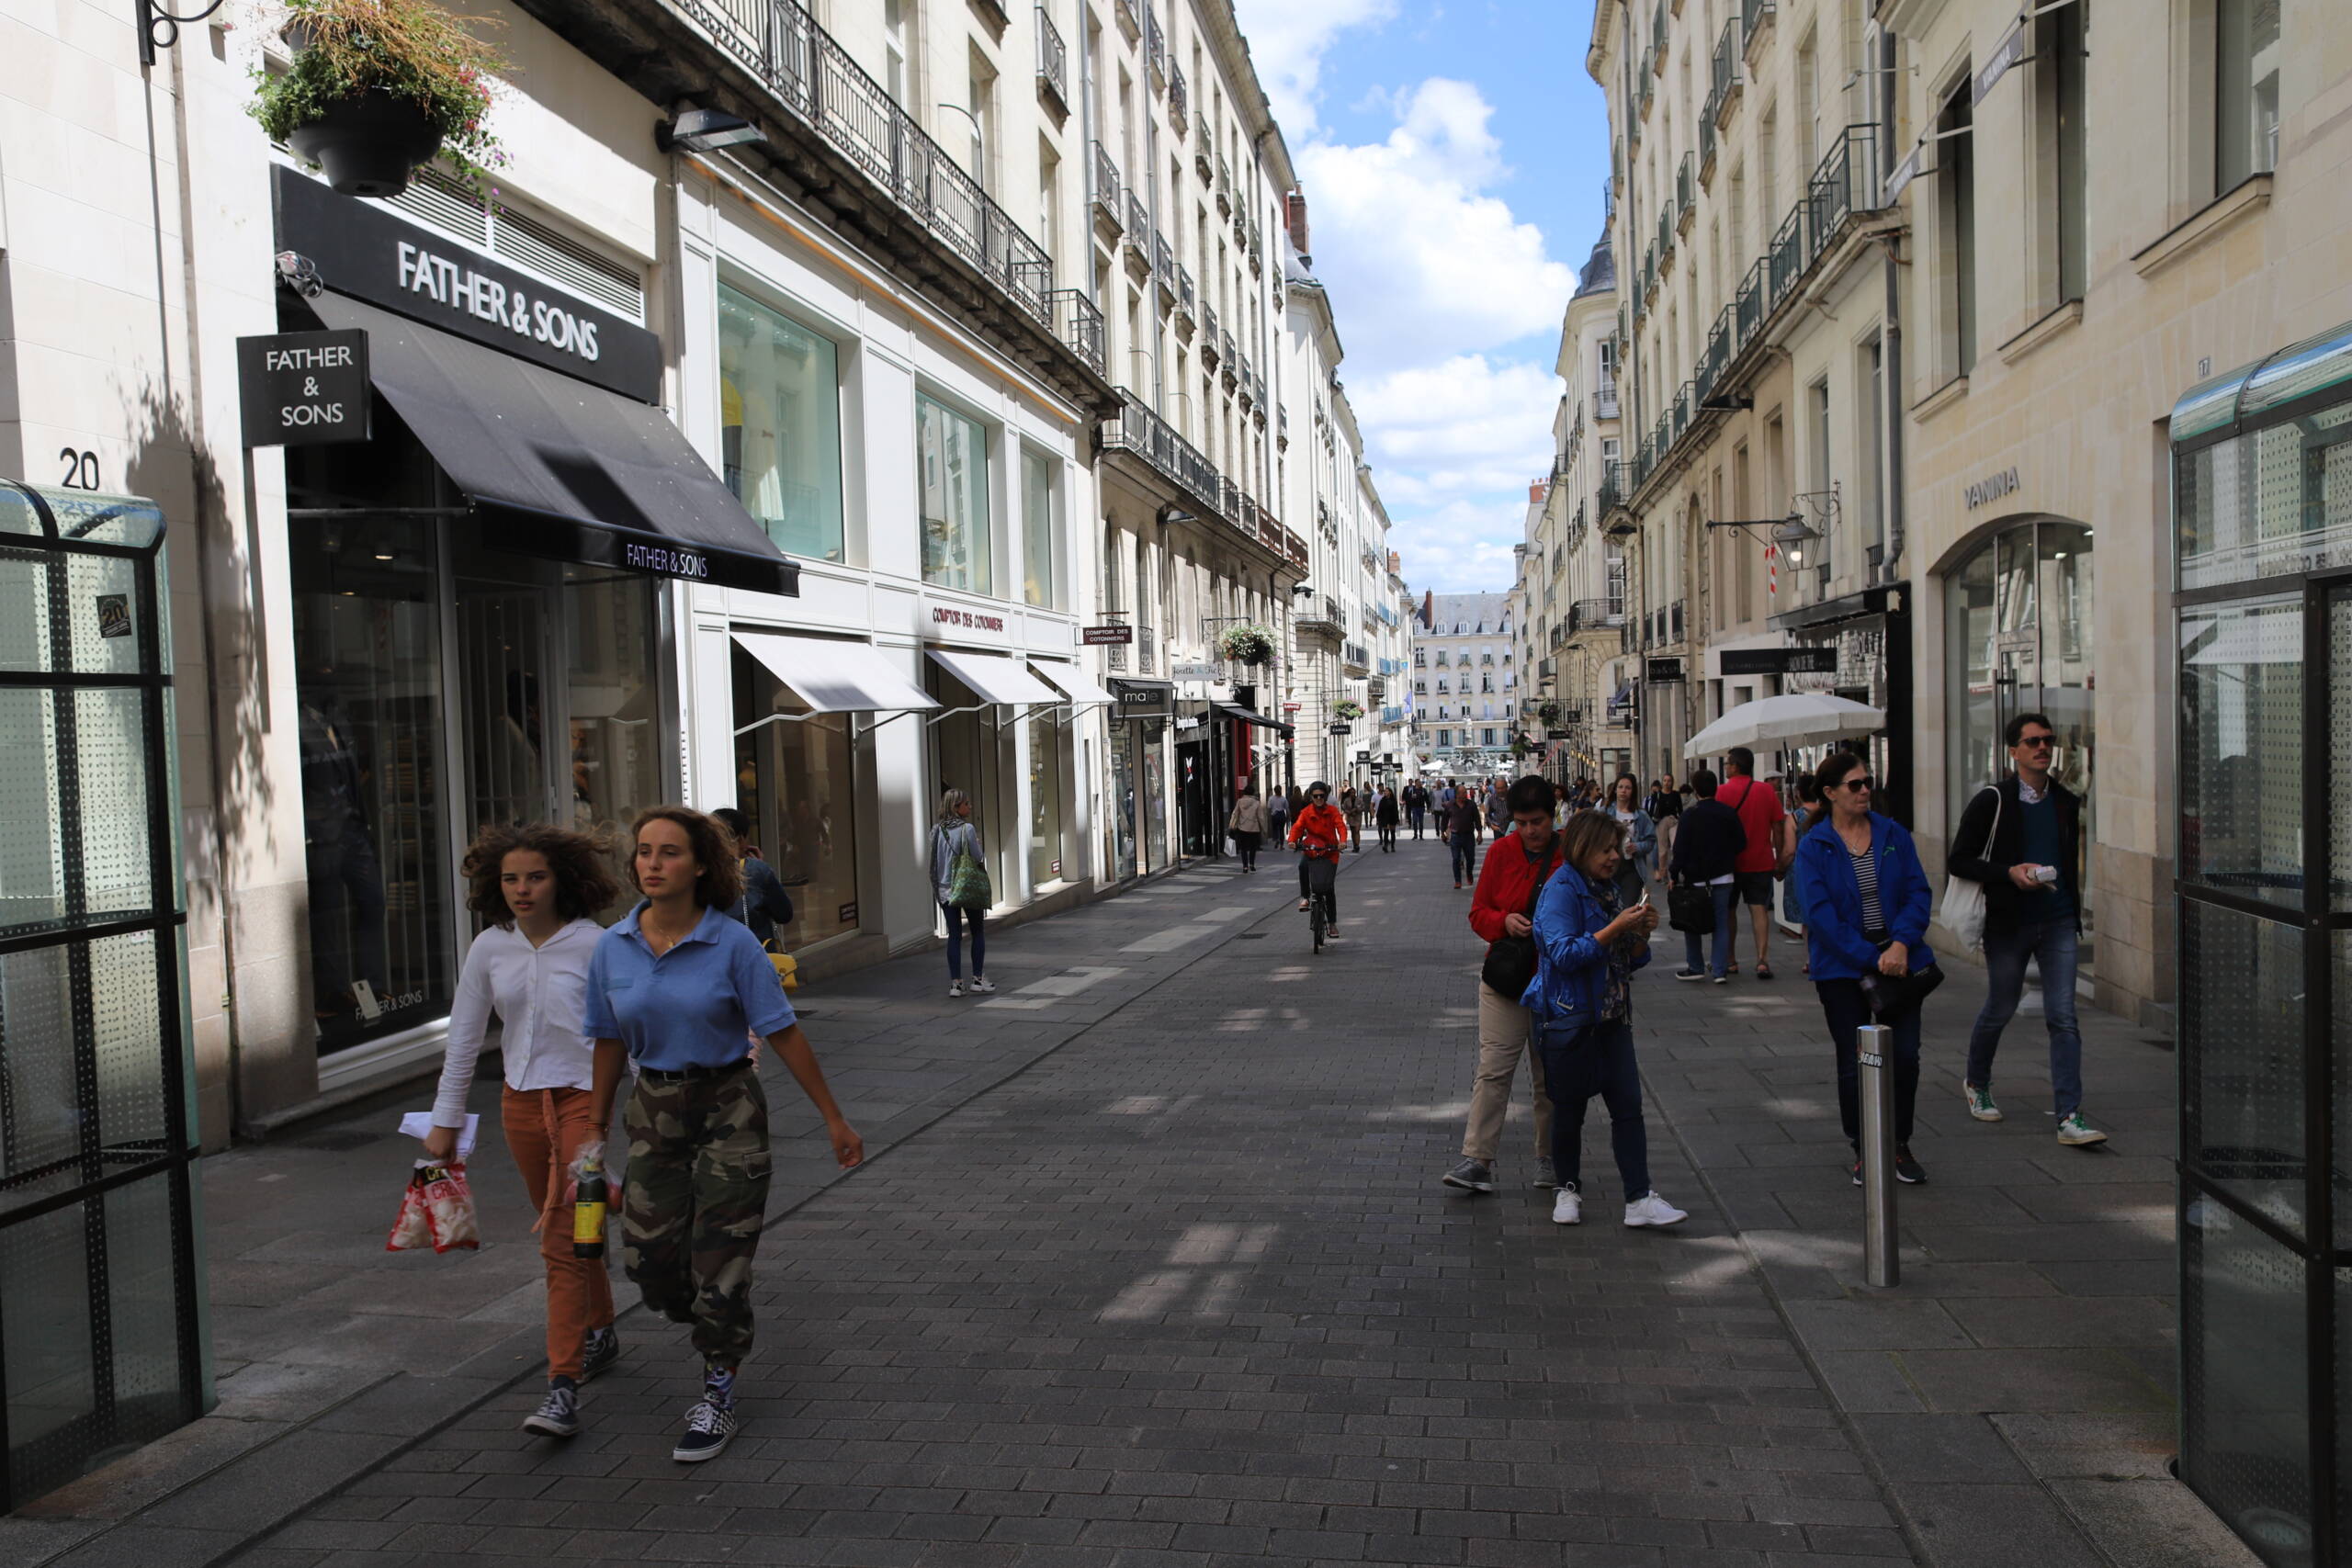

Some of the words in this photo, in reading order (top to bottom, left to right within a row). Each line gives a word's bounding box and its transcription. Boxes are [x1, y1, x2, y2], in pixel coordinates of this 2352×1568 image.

[398, 241, 511, 328] FATHER
[512, 292, 531, 337] &
[534, 300, 599, 361] SONS
[266, 346, 353, 371] FATHER
[303, 377, 319, 396] &
[281, 403, 344, 426] SONS
[60, 447, 99, 491] 20
[1962, 466, 2020, 511] VANINA
[627, 544, 668, 570] FATHER
[670, 552, 678, 573] &
[680, 554, 707, 577] SONS
[933, 607, 961, 625] COMPTOIR
[962, 611, 973, 628] DES
[974, 614, 1003, 632] COTONNIERS
[399, 990, 423, 1010] SONS
